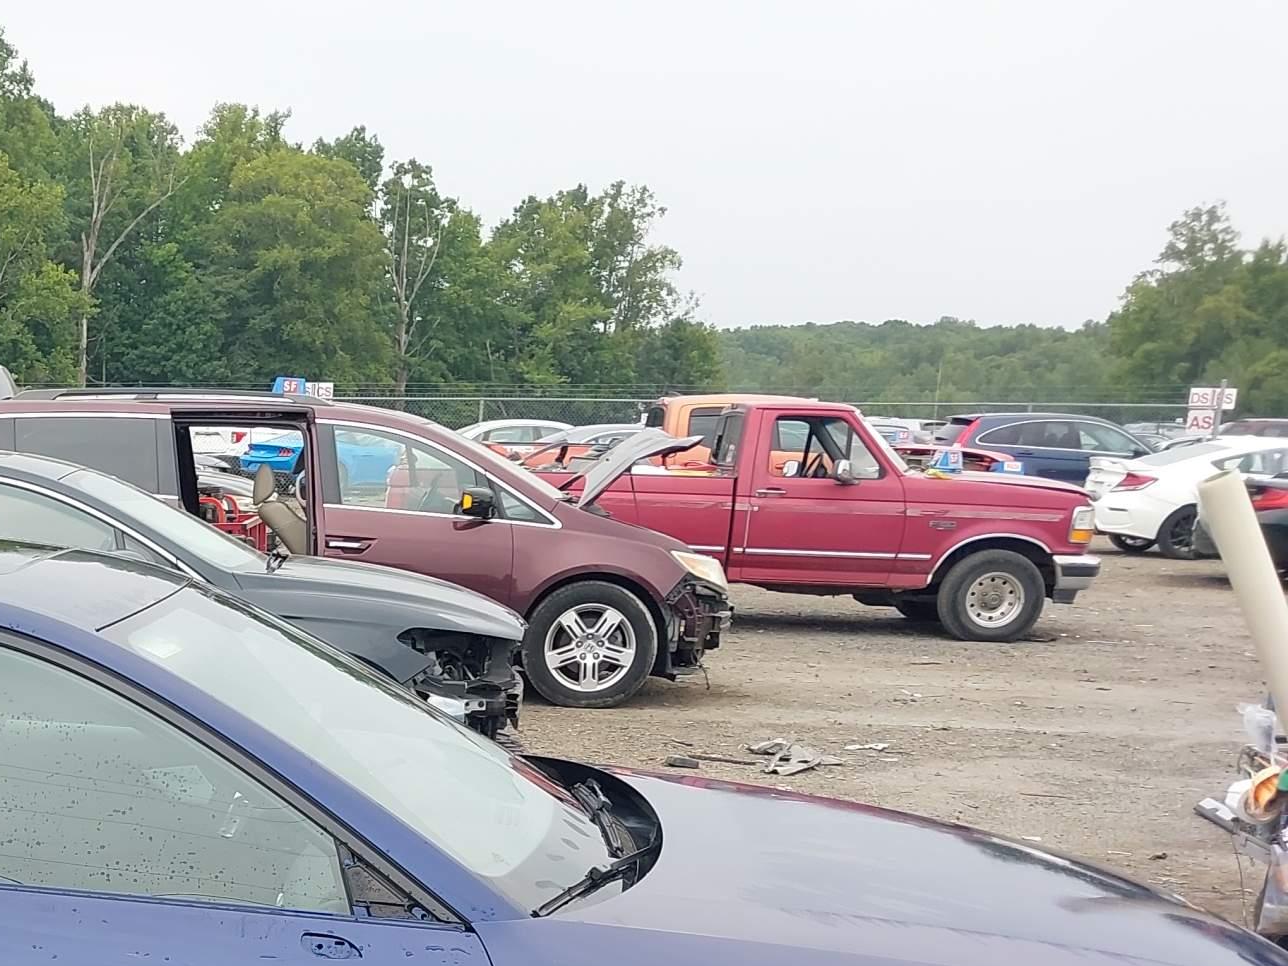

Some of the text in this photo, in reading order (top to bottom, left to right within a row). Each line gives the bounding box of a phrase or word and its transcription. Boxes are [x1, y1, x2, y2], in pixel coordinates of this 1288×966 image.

[283, 380, 298, 392] SF
[1192, 393, 1209, 404] DS
[1188, 416, 1212, 430] AS
